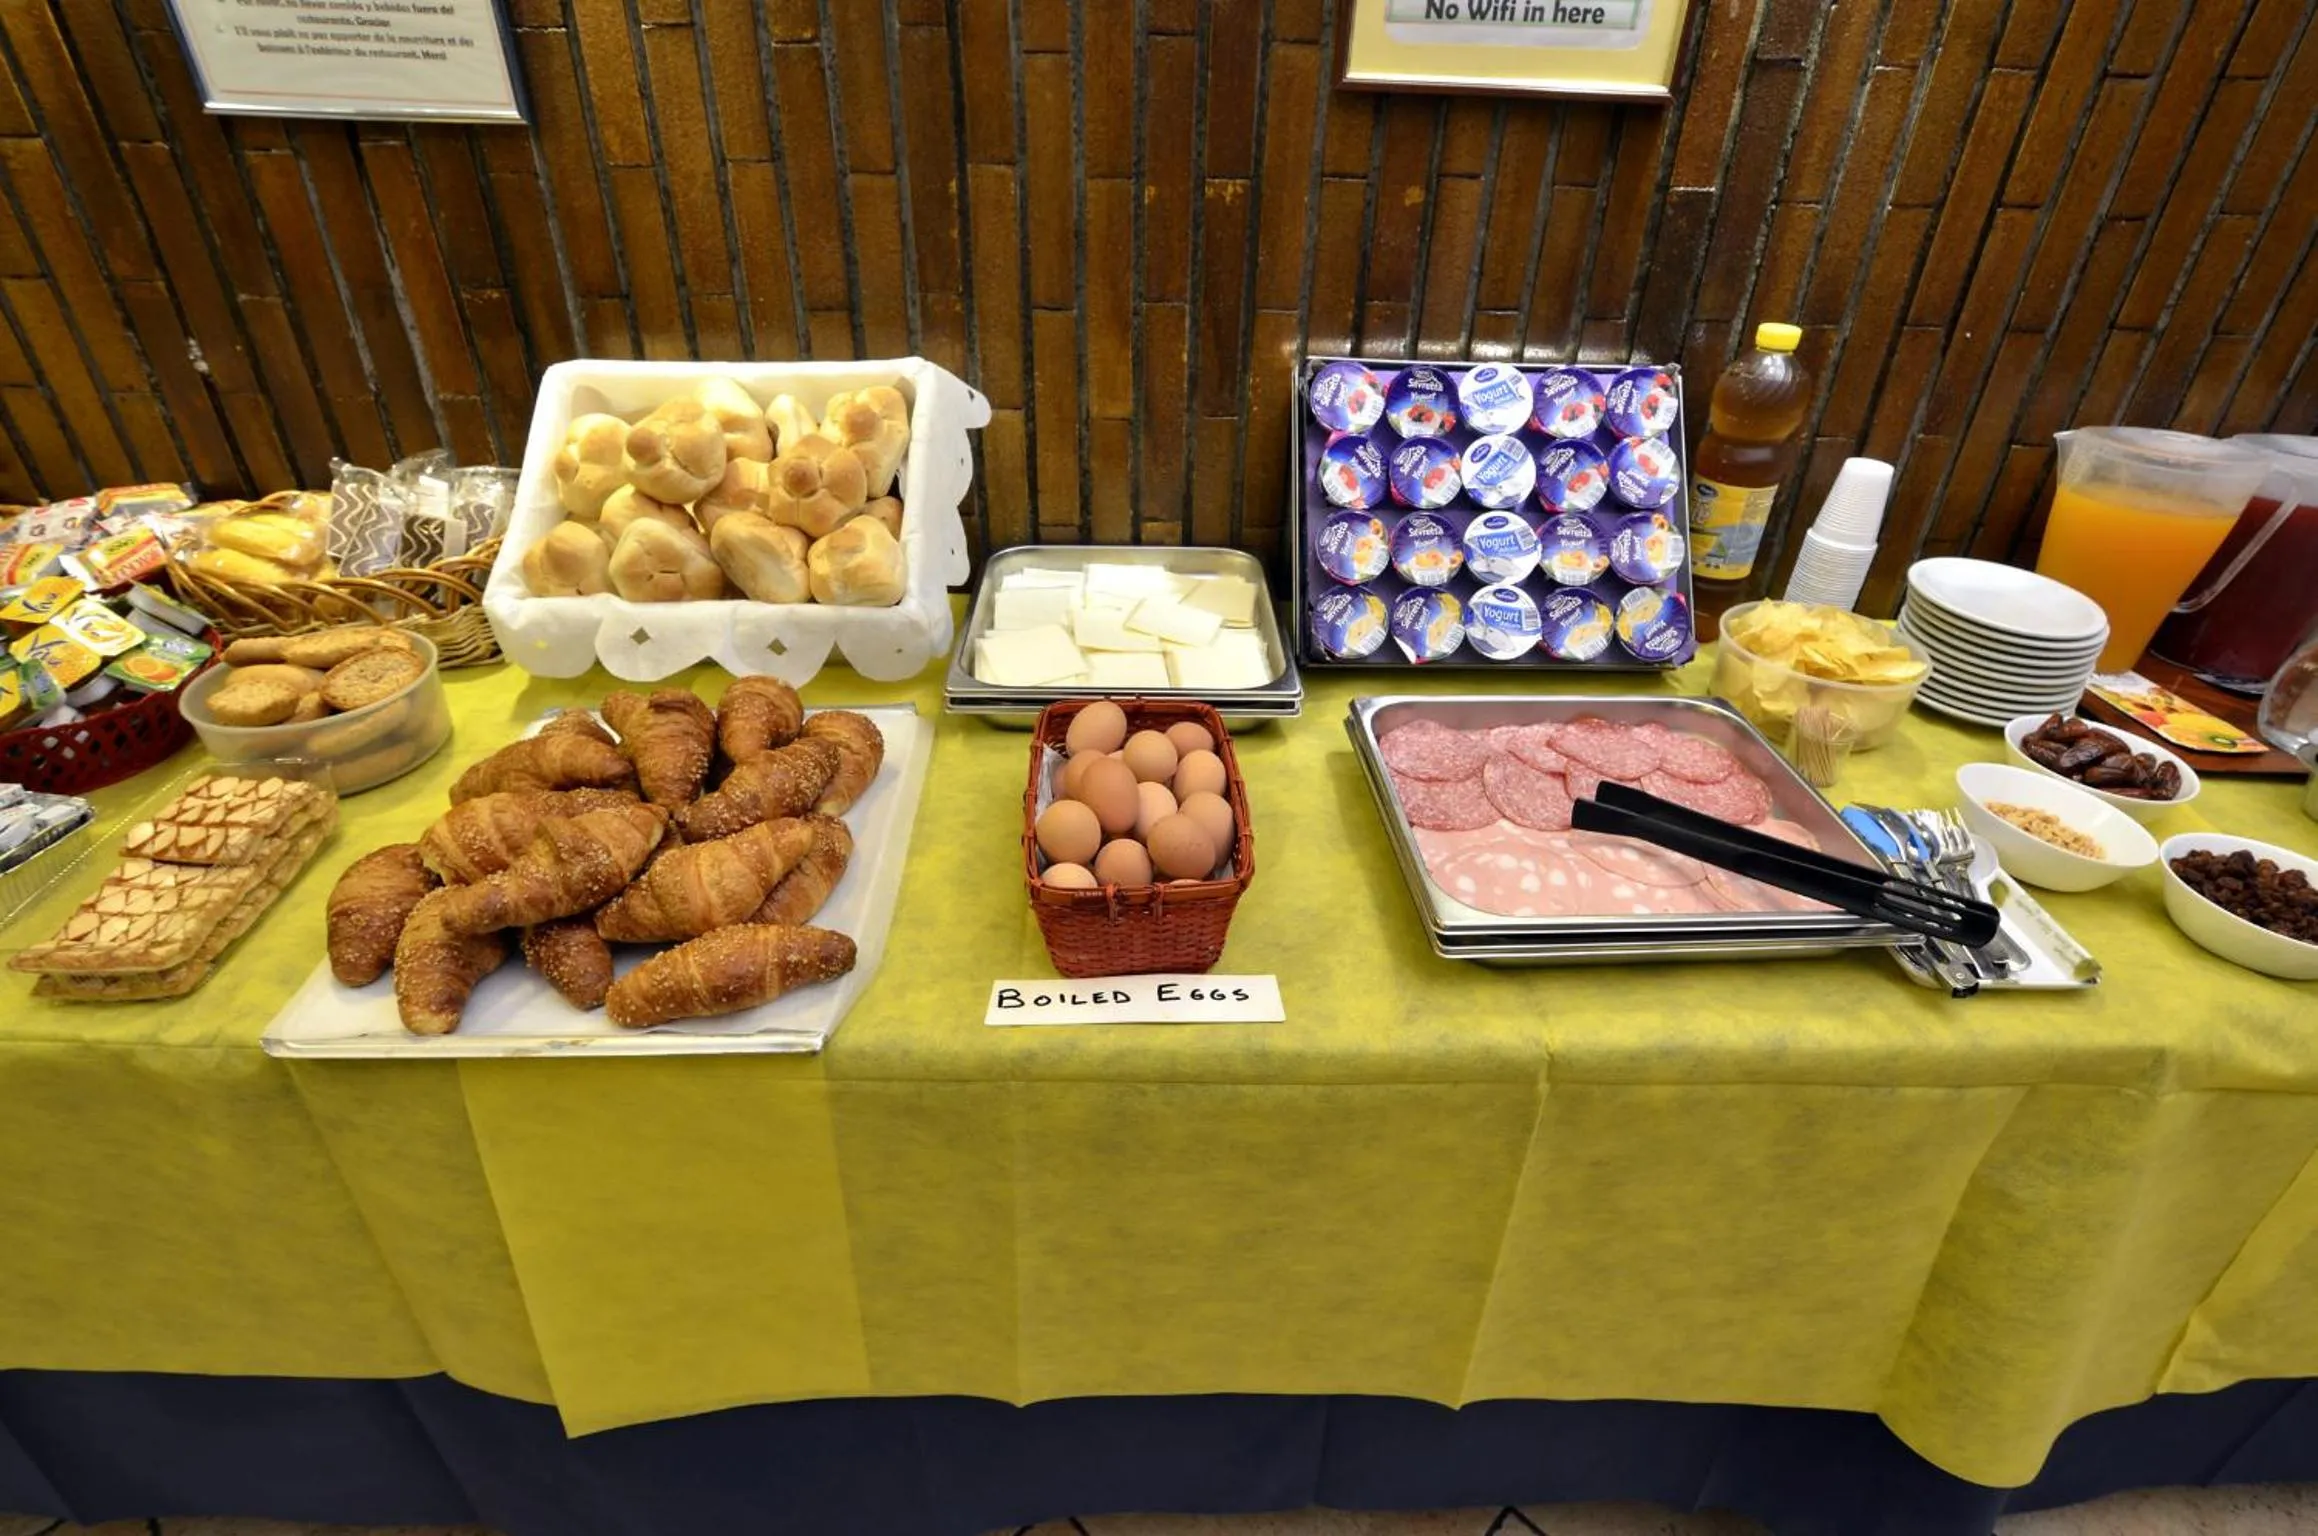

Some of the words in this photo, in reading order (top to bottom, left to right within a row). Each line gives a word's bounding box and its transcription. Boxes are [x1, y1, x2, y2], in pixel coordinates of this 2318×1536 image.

[1424, 0, 1460, 20] No
[1467, 0, 1516, 22] Wifi
[1523, 0, 1545, 23] in
[1552, 0, 1605, 25] here
[1472, 379, 1509, 402] Yogurt
[1476, 452, 1509, 483] Yogurt
[1479, 531, 1515, 549] Yogurt
[1484, 605, 1520, 622] Yogurt
[997, 987, 1132, 1009] BOILED
[1156, 983, 1250, 1002] EGGS
